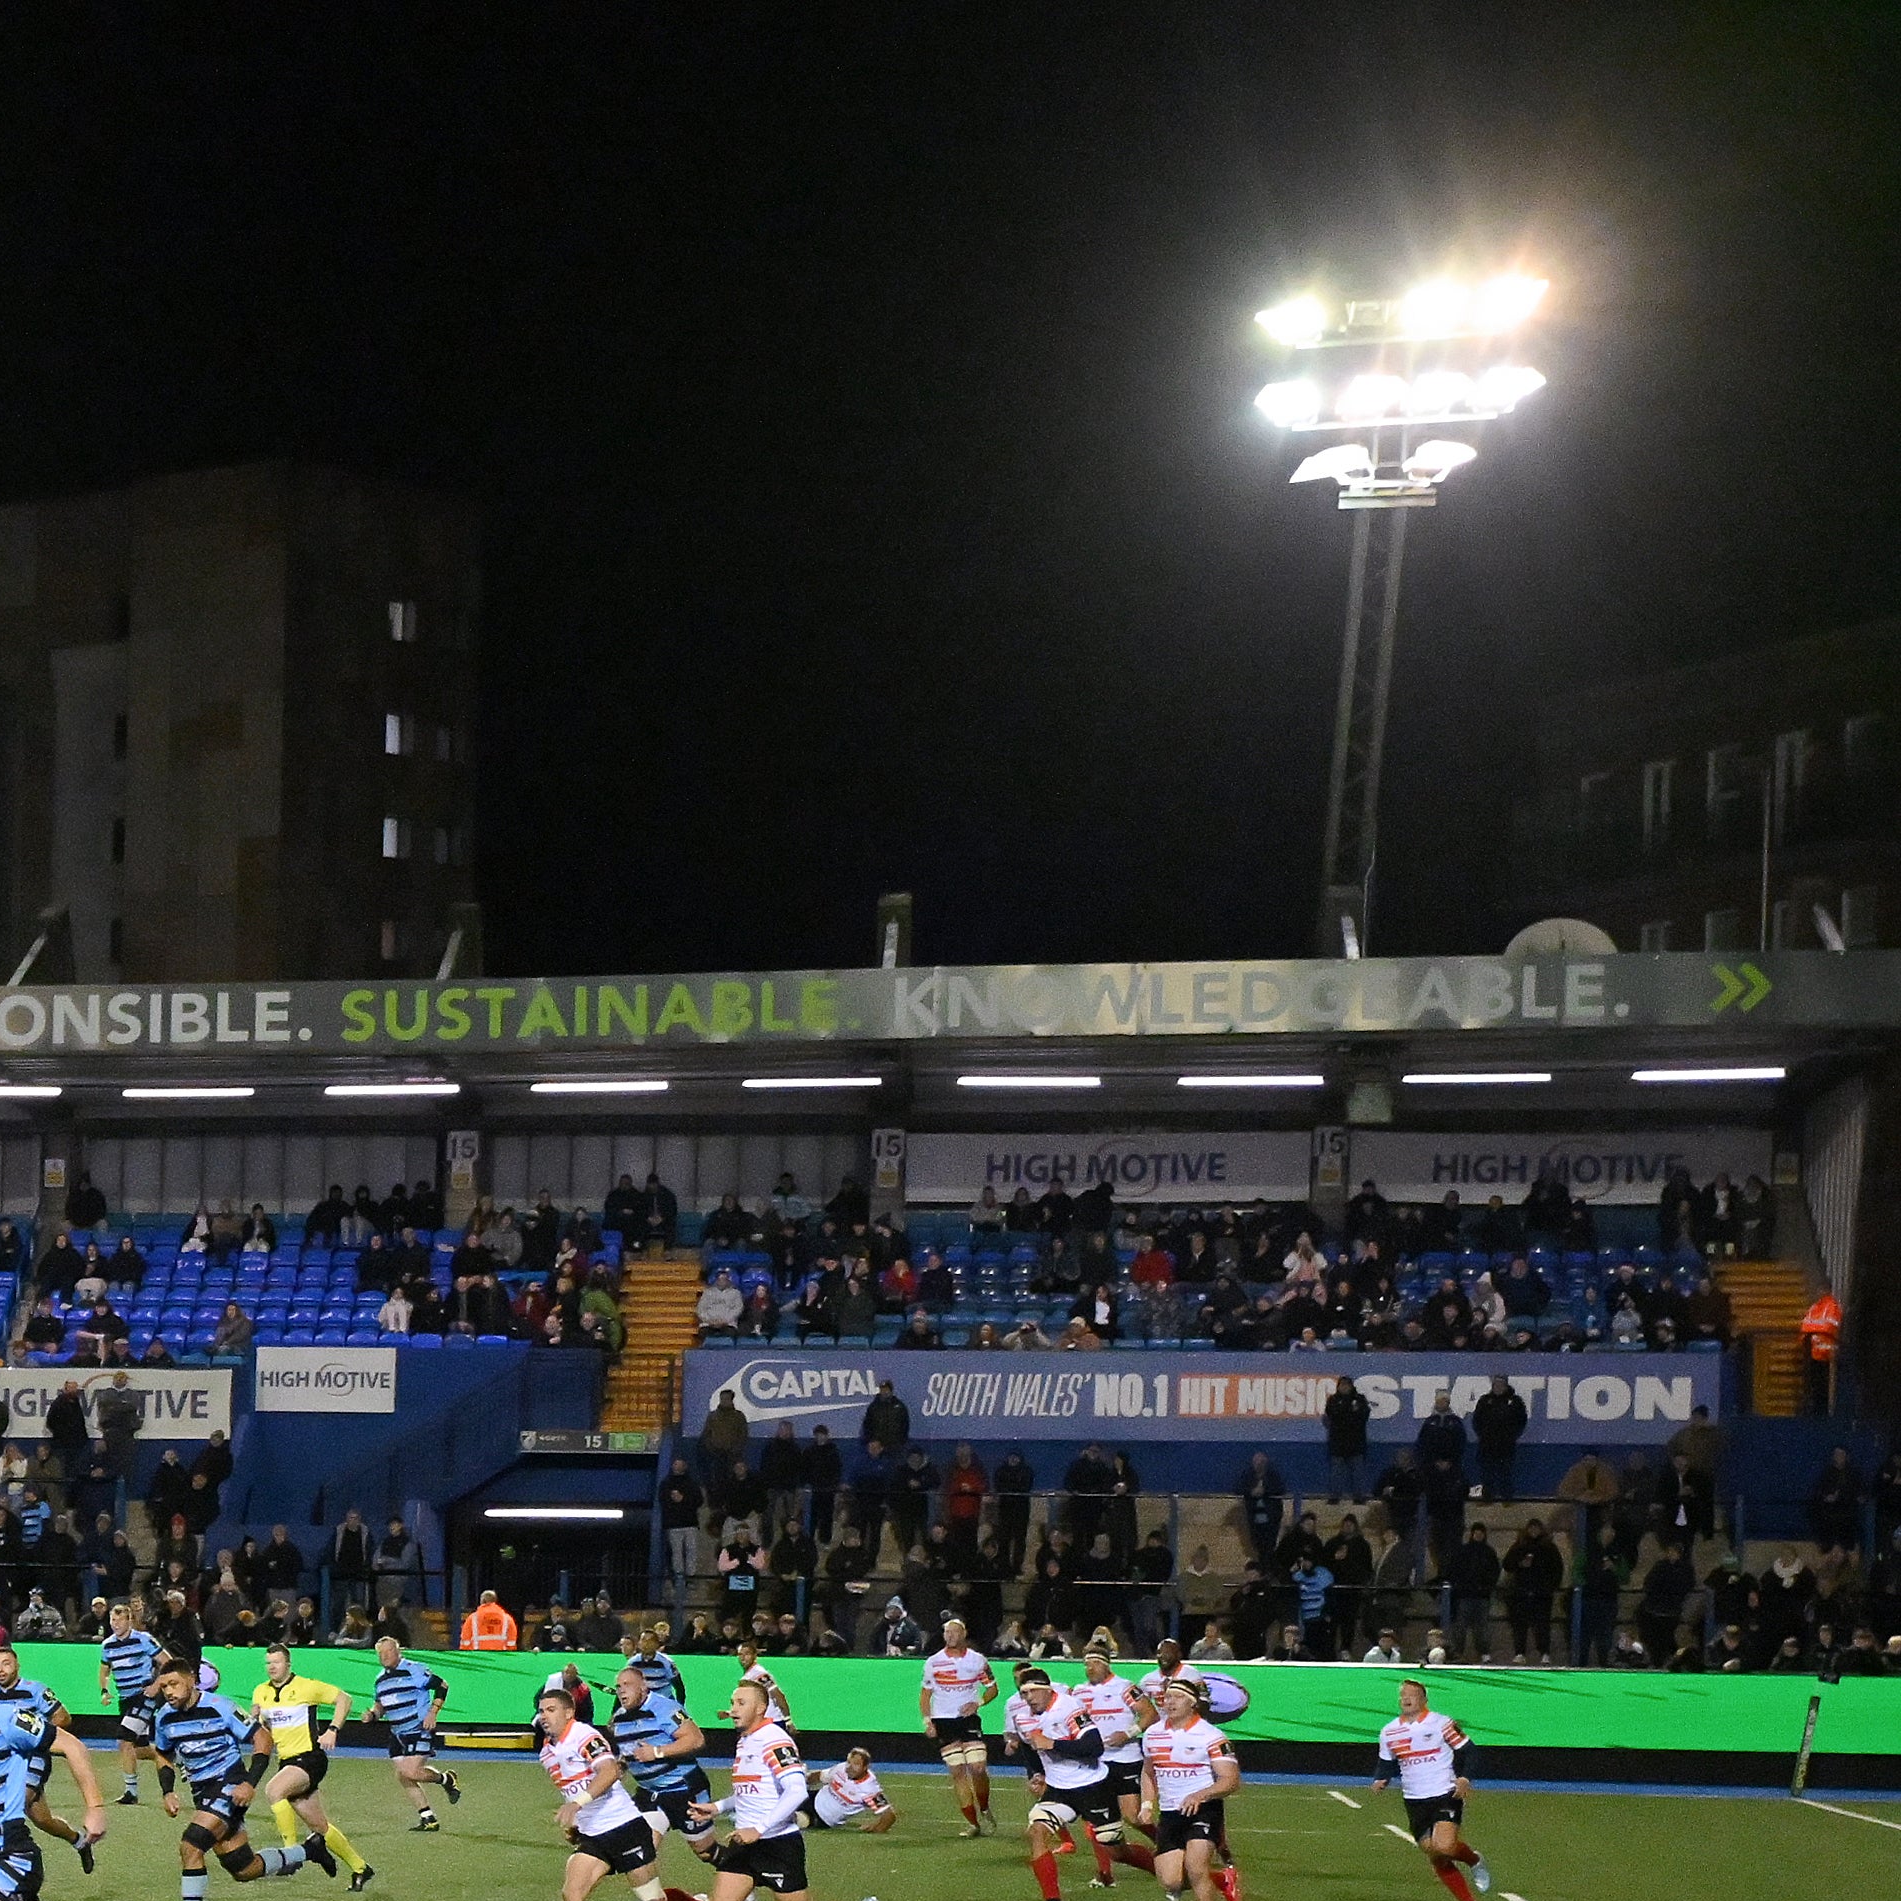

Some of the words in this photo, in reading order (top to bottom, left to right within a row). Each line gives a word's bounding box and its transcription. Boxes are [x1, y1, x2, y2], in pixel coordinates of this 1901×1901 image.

[340, 978, 862, 1043] SUSTAINABLE.
[892, 962, 1629, 1032] KNOWLEDGEABLE.
[451, 1136, 475, 1159] 15
[876, 1134, 901, 1157] 15
[1320, 1132, 1344, 1154] 15
[986, 1153, 1075, 1183] HIGH
[1084, 1152, 1226, 1183] MOTIVE
[1432, 1153, 1527, 1183] HIGH
[1538, 1153, 1685, 1183] MOTIVE
[260, 1370, 310, 1387] HIGH
[315, 1370, 391, 1389] MOTIVE
[749, 1369, 881, 1400] CAPITAL
[77, 1389, 210, 1419] MTIVE
[922, 1372, 1001, 1417] SOUTH
[1095, 1373, 1170, 1418] NO.1
[1179, 1377, 1229, 1415] HIT
[1354, 1374, 1694, 1422] STATION
[583, 1435, 603, 1449] 15
[561, 1778, 593, 1798] YOTA
[735, 1783, 760, 1796] OTA
